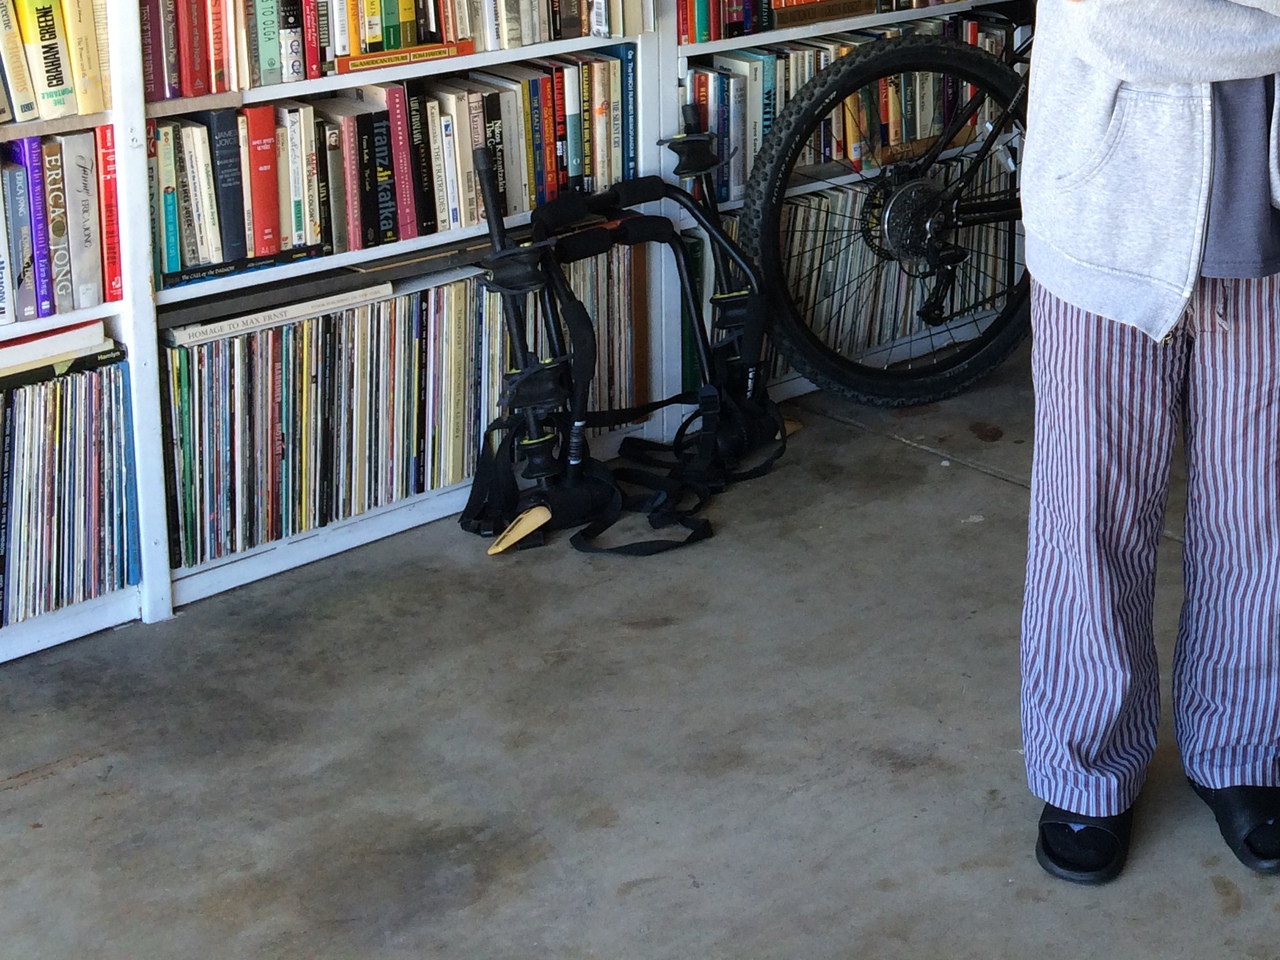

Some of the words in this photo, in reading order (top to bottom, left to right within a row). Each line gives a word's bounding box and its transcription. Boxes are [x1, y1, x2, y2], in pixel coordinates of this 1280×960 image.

[35, 4, 59, 43] GREENE
[261, 8, 274, 18] TO
[211, 12, 224, 61] HARDY
[262, 20, 276, 43] OLGA
[4, 32, 28, 93] Reflections
[359, 55, 387, 68] AMERICAN
[387, 51, 408, 63] FUTURE
[411, 49, 424, 59] TOM
[424, 45, 447, 56] HAYDEN
[627, 50, 634, 59] Oe
[39, 44, 64, 89] GRAHAM
[41, 87, 73, 100] PORTABLE
[53, 98, 66, 107] THE
[612, 101, 620, 114] THE
[612, 115, 620, 135] SILENT
[31, 140, 41, 164] what
[373, 119, 391, 168] franz
[433, 146, 441, 160] THE
[15, 171, 25, 196] ERICA
[44, 153, 65, 220] ERICA
[435, 161, 446, 214] FRATRICIDES
[17, 196, 26, 217] JONG
[81, 199, 91, 223] ERICA
[377, 179, 396, 232] kafka
[82, 224, 92, 249] JONG
[49, 243, 71, 296] JONG
[187, 324, 224, 341] HOMAGE
[228, 321, 240, 332] TO
[241, 316, 261, 329] MAX
[263, 311, 288, 324] ERNST
[97, 351, 121, 362] Hamlyn
